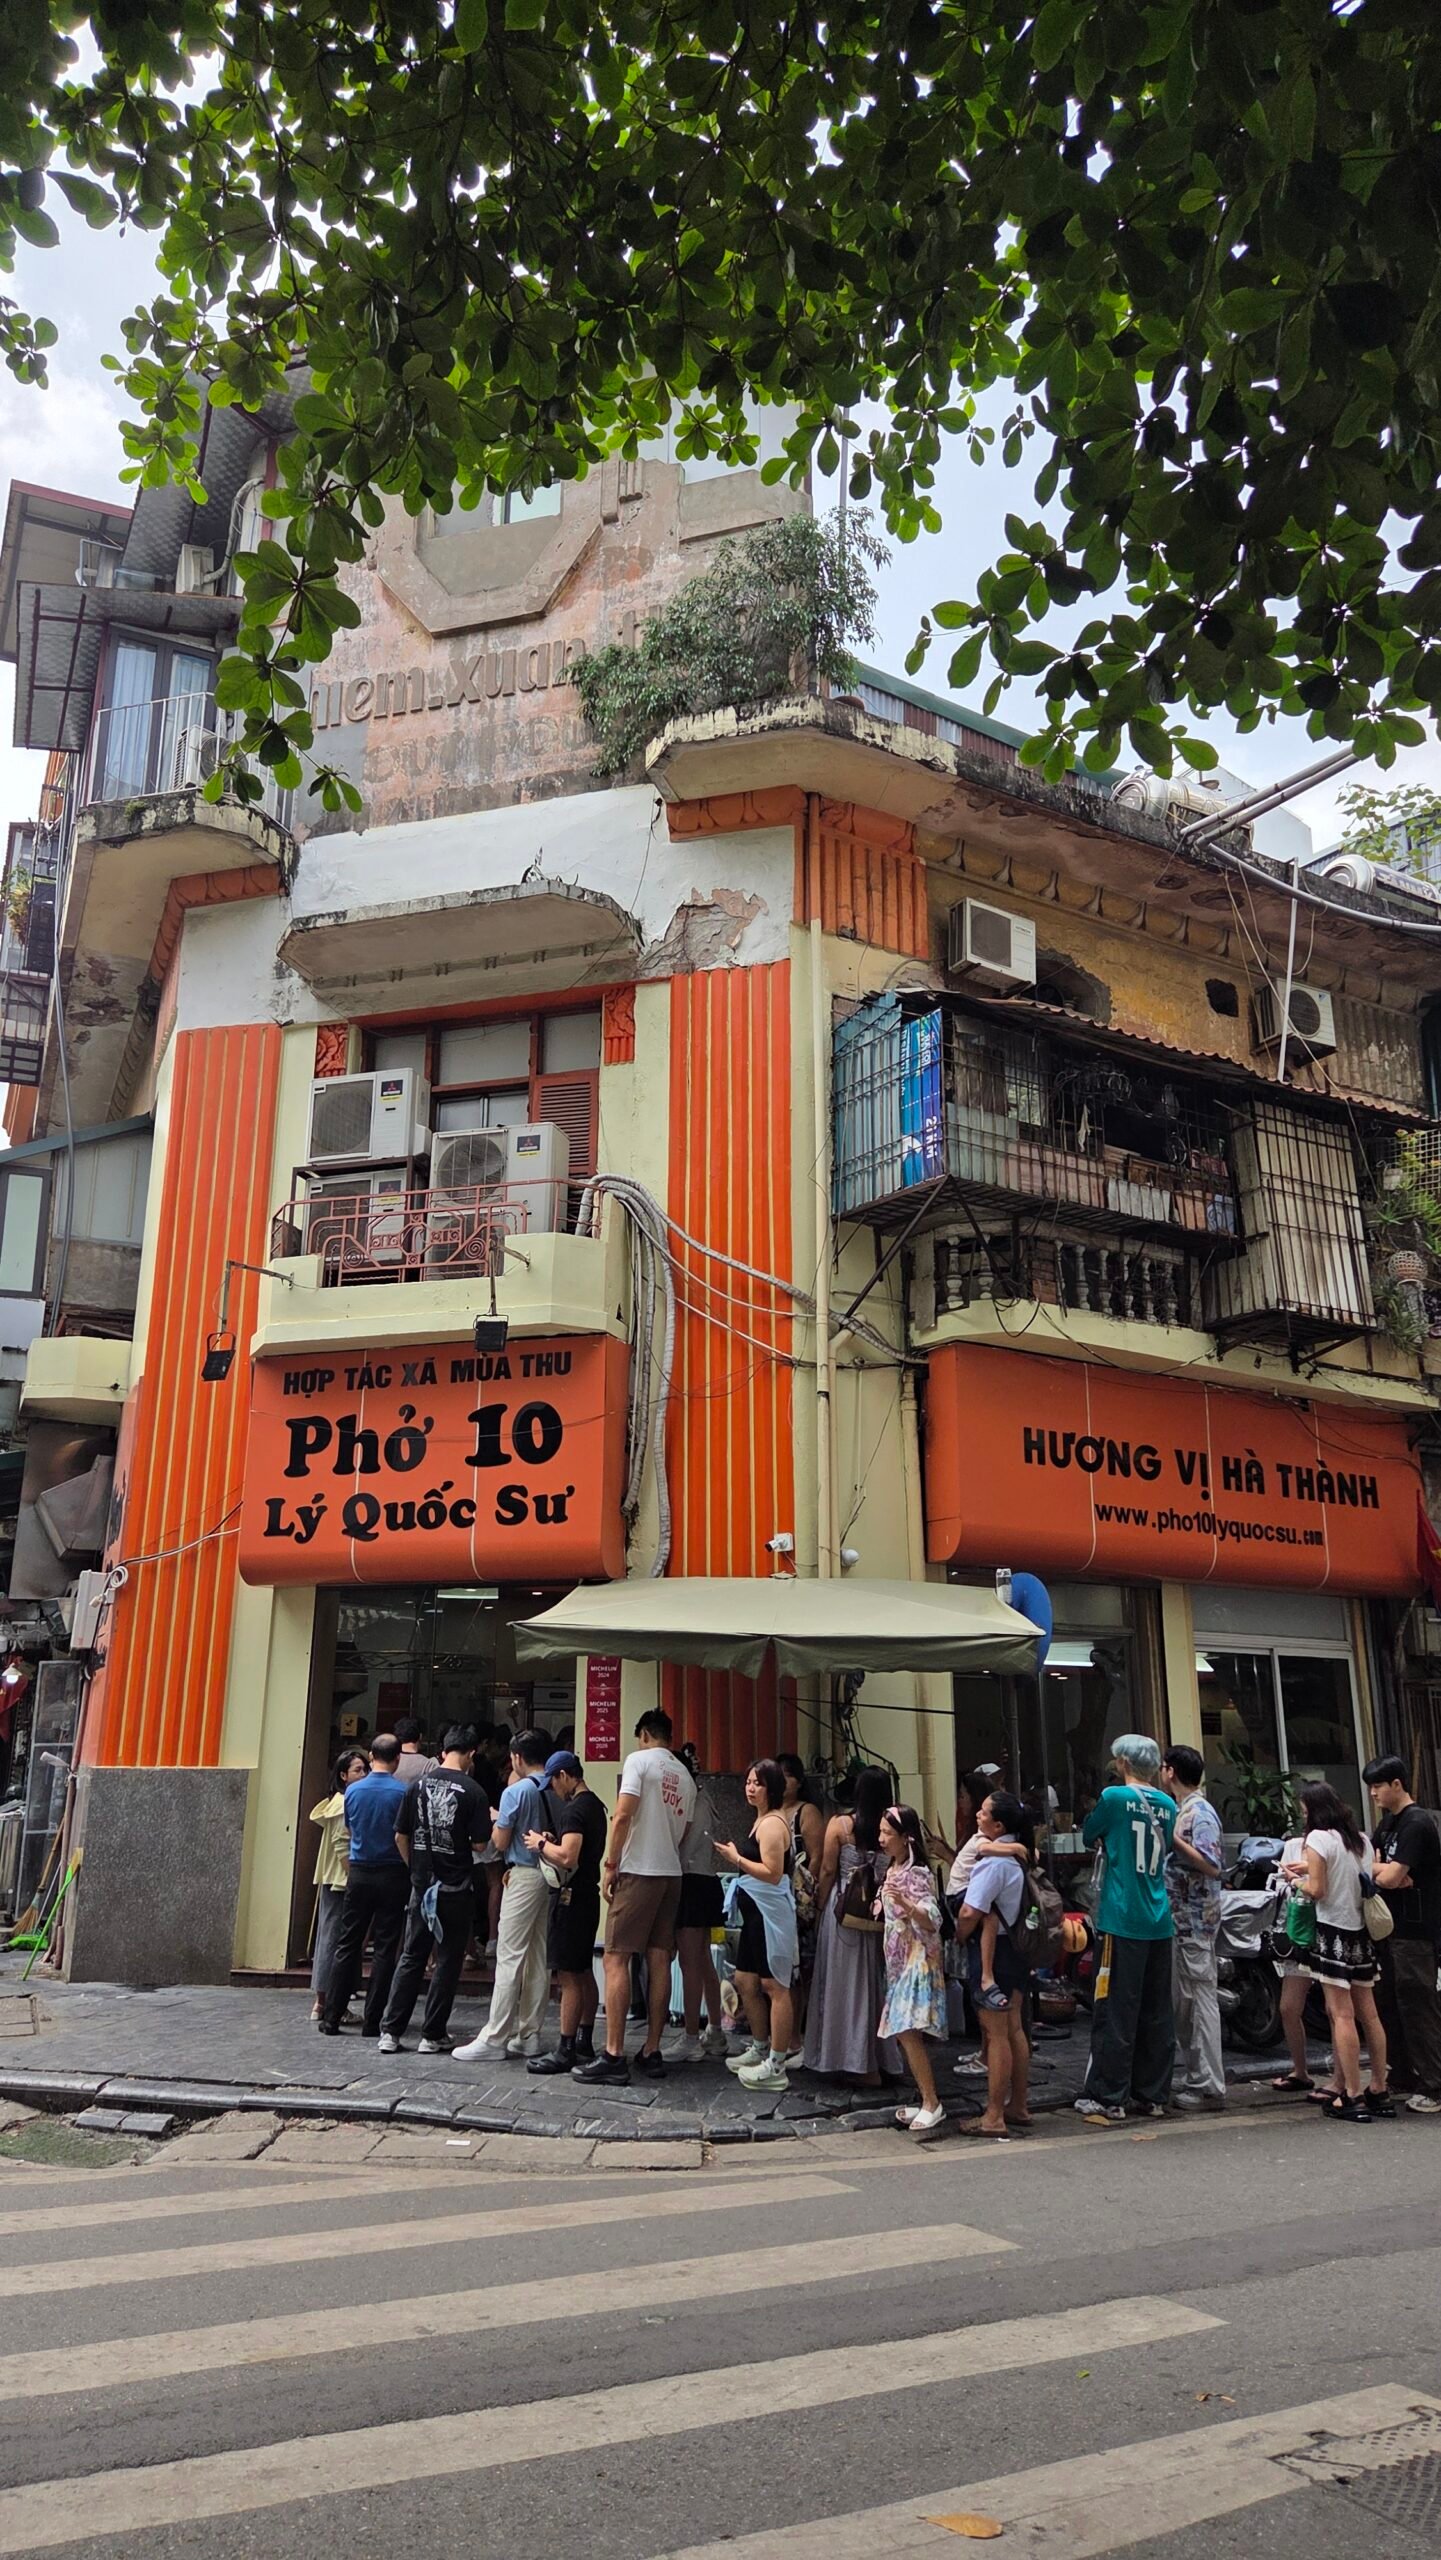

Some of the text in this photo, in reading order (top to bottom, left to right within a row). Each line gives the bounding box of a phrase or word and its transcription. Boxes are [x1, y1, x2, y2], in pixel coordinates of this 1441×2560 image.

[284, 1351, 572, 1399] HỢP TÁC XÃ MÙA THU
[284, 1401, 563, 1477] Phở 10
[1023, 1427, 1380, 1509] HƯƠNG VỊ HÀ THÀNH
[263, 1481, 575, 1544] Lý Quốc Sư
[1132, 1820, 1162, 1877] 11
